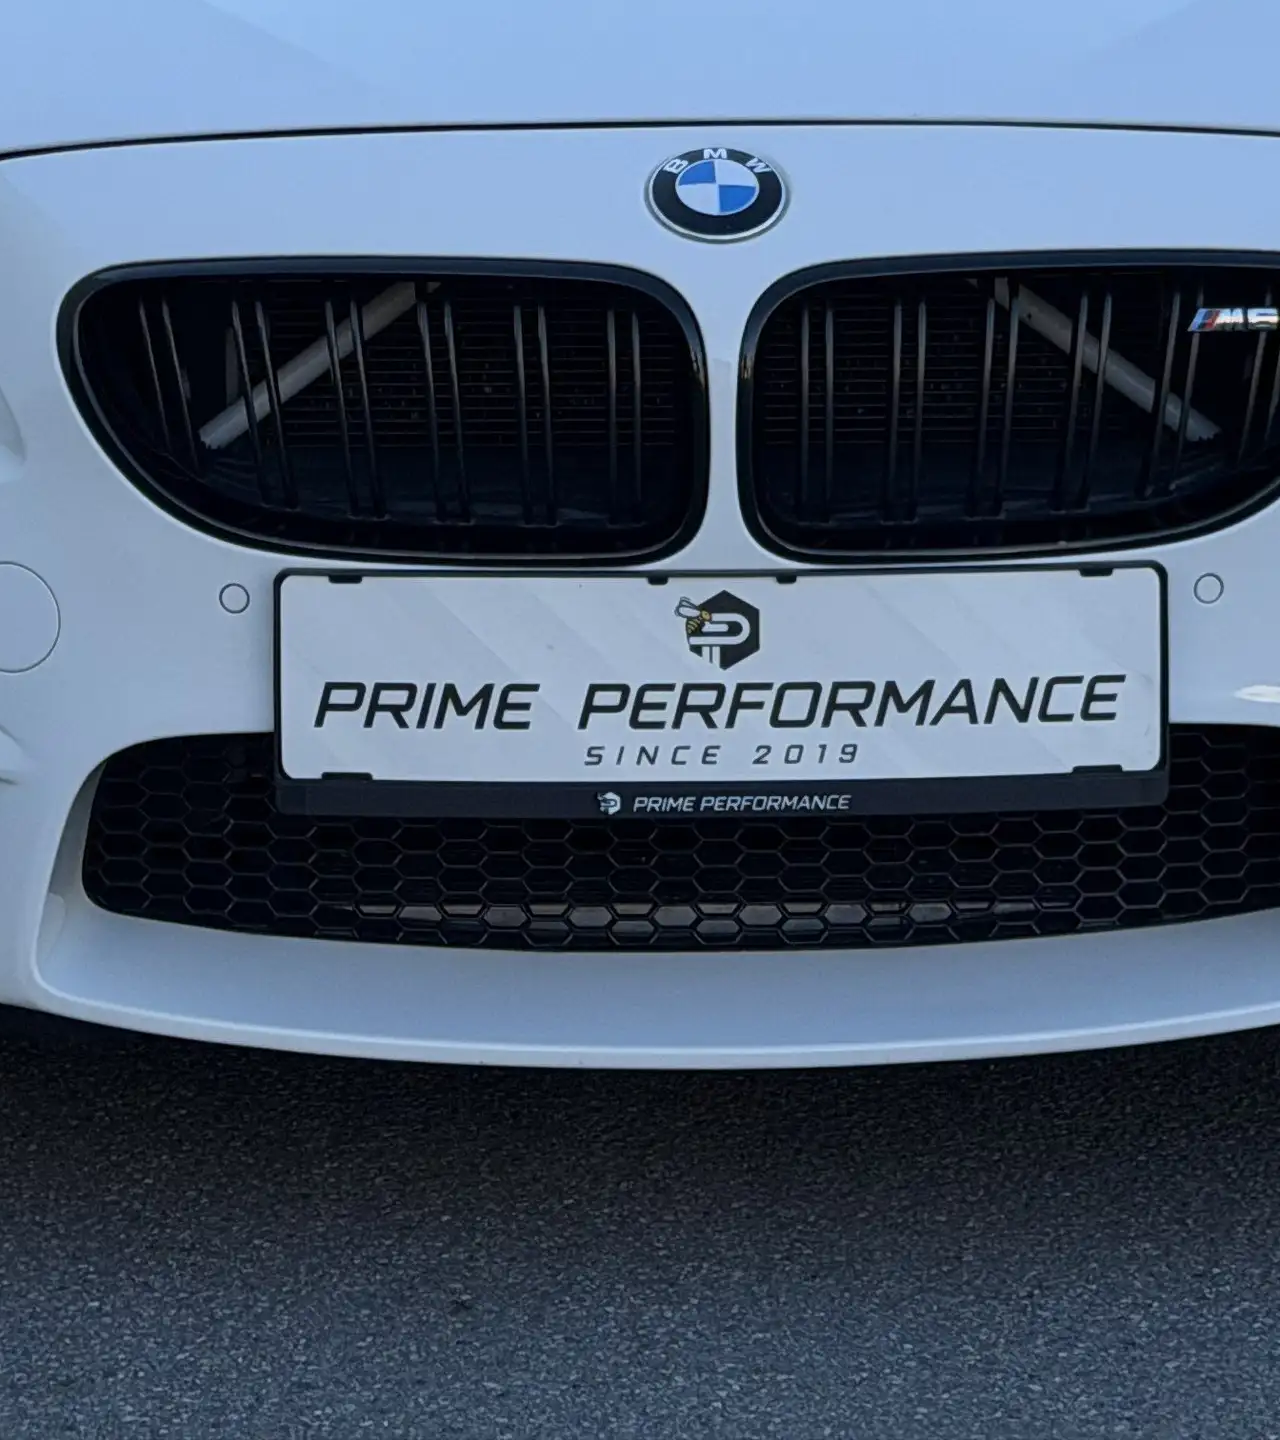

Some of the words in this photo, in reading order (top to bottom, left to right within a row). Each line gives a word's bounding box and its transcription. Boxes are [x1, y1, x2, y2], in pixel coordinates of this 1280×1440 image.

[663, 148, 773, 174] BMW
[314, 682, 540, 730] PRIME
[577, 674, 1126, 730] PERFORMANCE
[584, 745, 720, 766] SINCE
[752, 744, 858, 765] 2019
[633, 796, 696, 812] PRIME
[699, 794, 852, 812] PERFORMANCE
